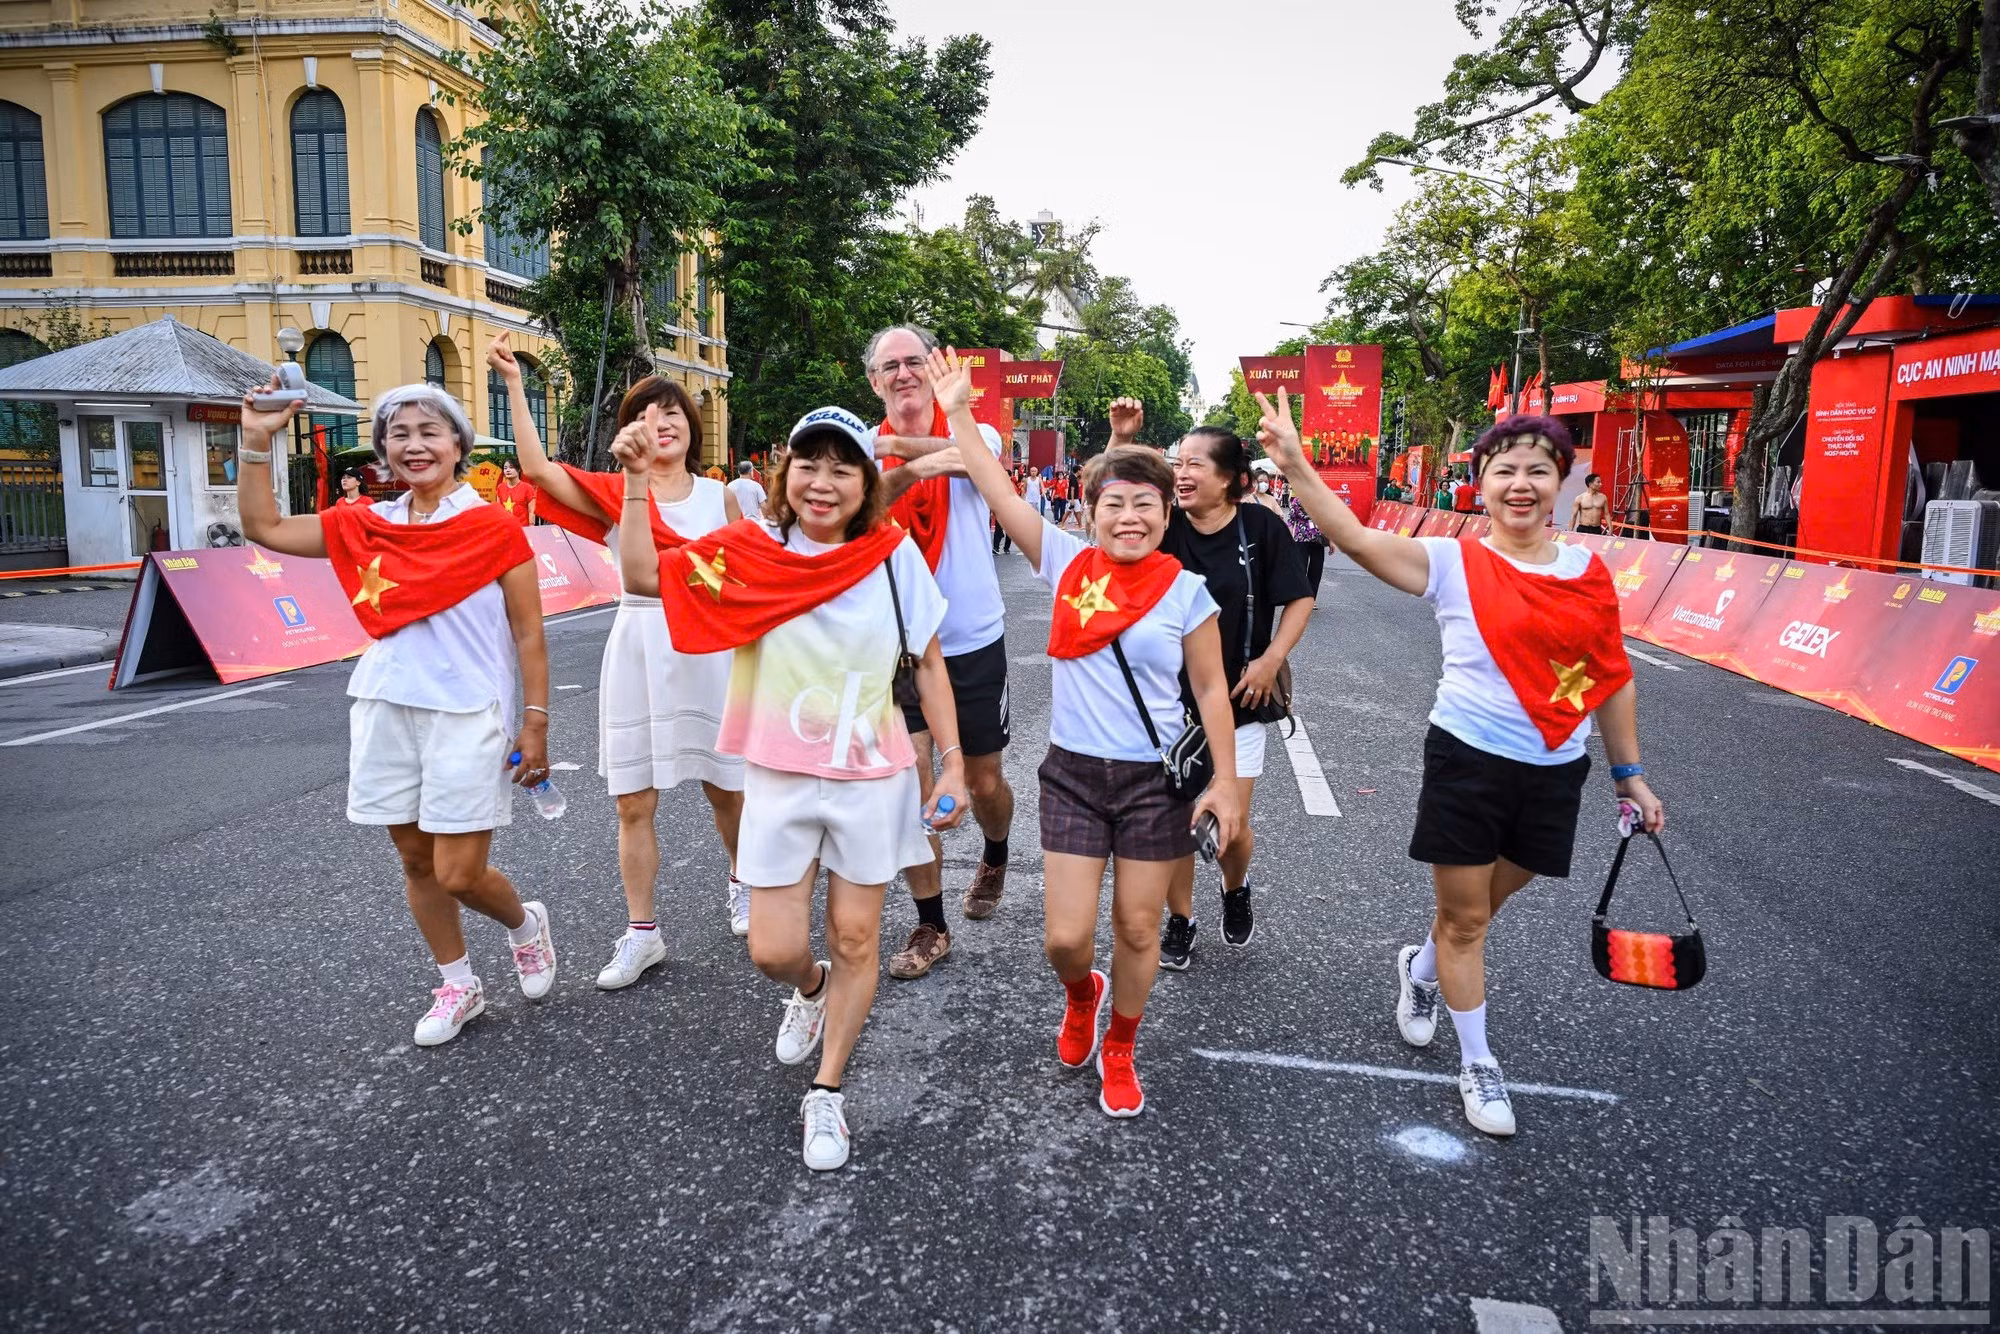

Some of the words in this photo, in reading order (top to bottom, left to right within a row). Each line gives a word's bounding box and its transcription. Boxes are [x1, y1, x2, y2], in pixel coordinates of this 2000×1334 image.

[1249, 368, 1274, 379] XUẤT
[1276, 369, 1300, 379] PHÁT
[1897, 361, 1922, 388] CỤC
[1923, 358, 1943, 380] AN
[1944, 352, 1978, 378] NINH
[1005, 372, 1029, 384] XUẤT
[1030, 373, 1054, 384] PHÁT
[1555, 395, 1570, 405] HÌNH
[1815, 409, 1830, 417] BÌNH
[1830, 408, 1843, 416] DÂN
[1843, 408, 1857, 416] HỌC
[1857, 407, 1867, 415] VỤ
[1866, 406, 1877, 415] SỐ
[1821, 435, 1845, 443] CHUYỂN
[1845, 434, 1855, 442] ĐỔI
[1855, 433, 1865, 442] SỐ
[1672, 604, 1726, 632] Vietcombank
[1778, 620, 1841, 659] GELEX
[1922, 691, 1956, 706] PETROLIMEX
